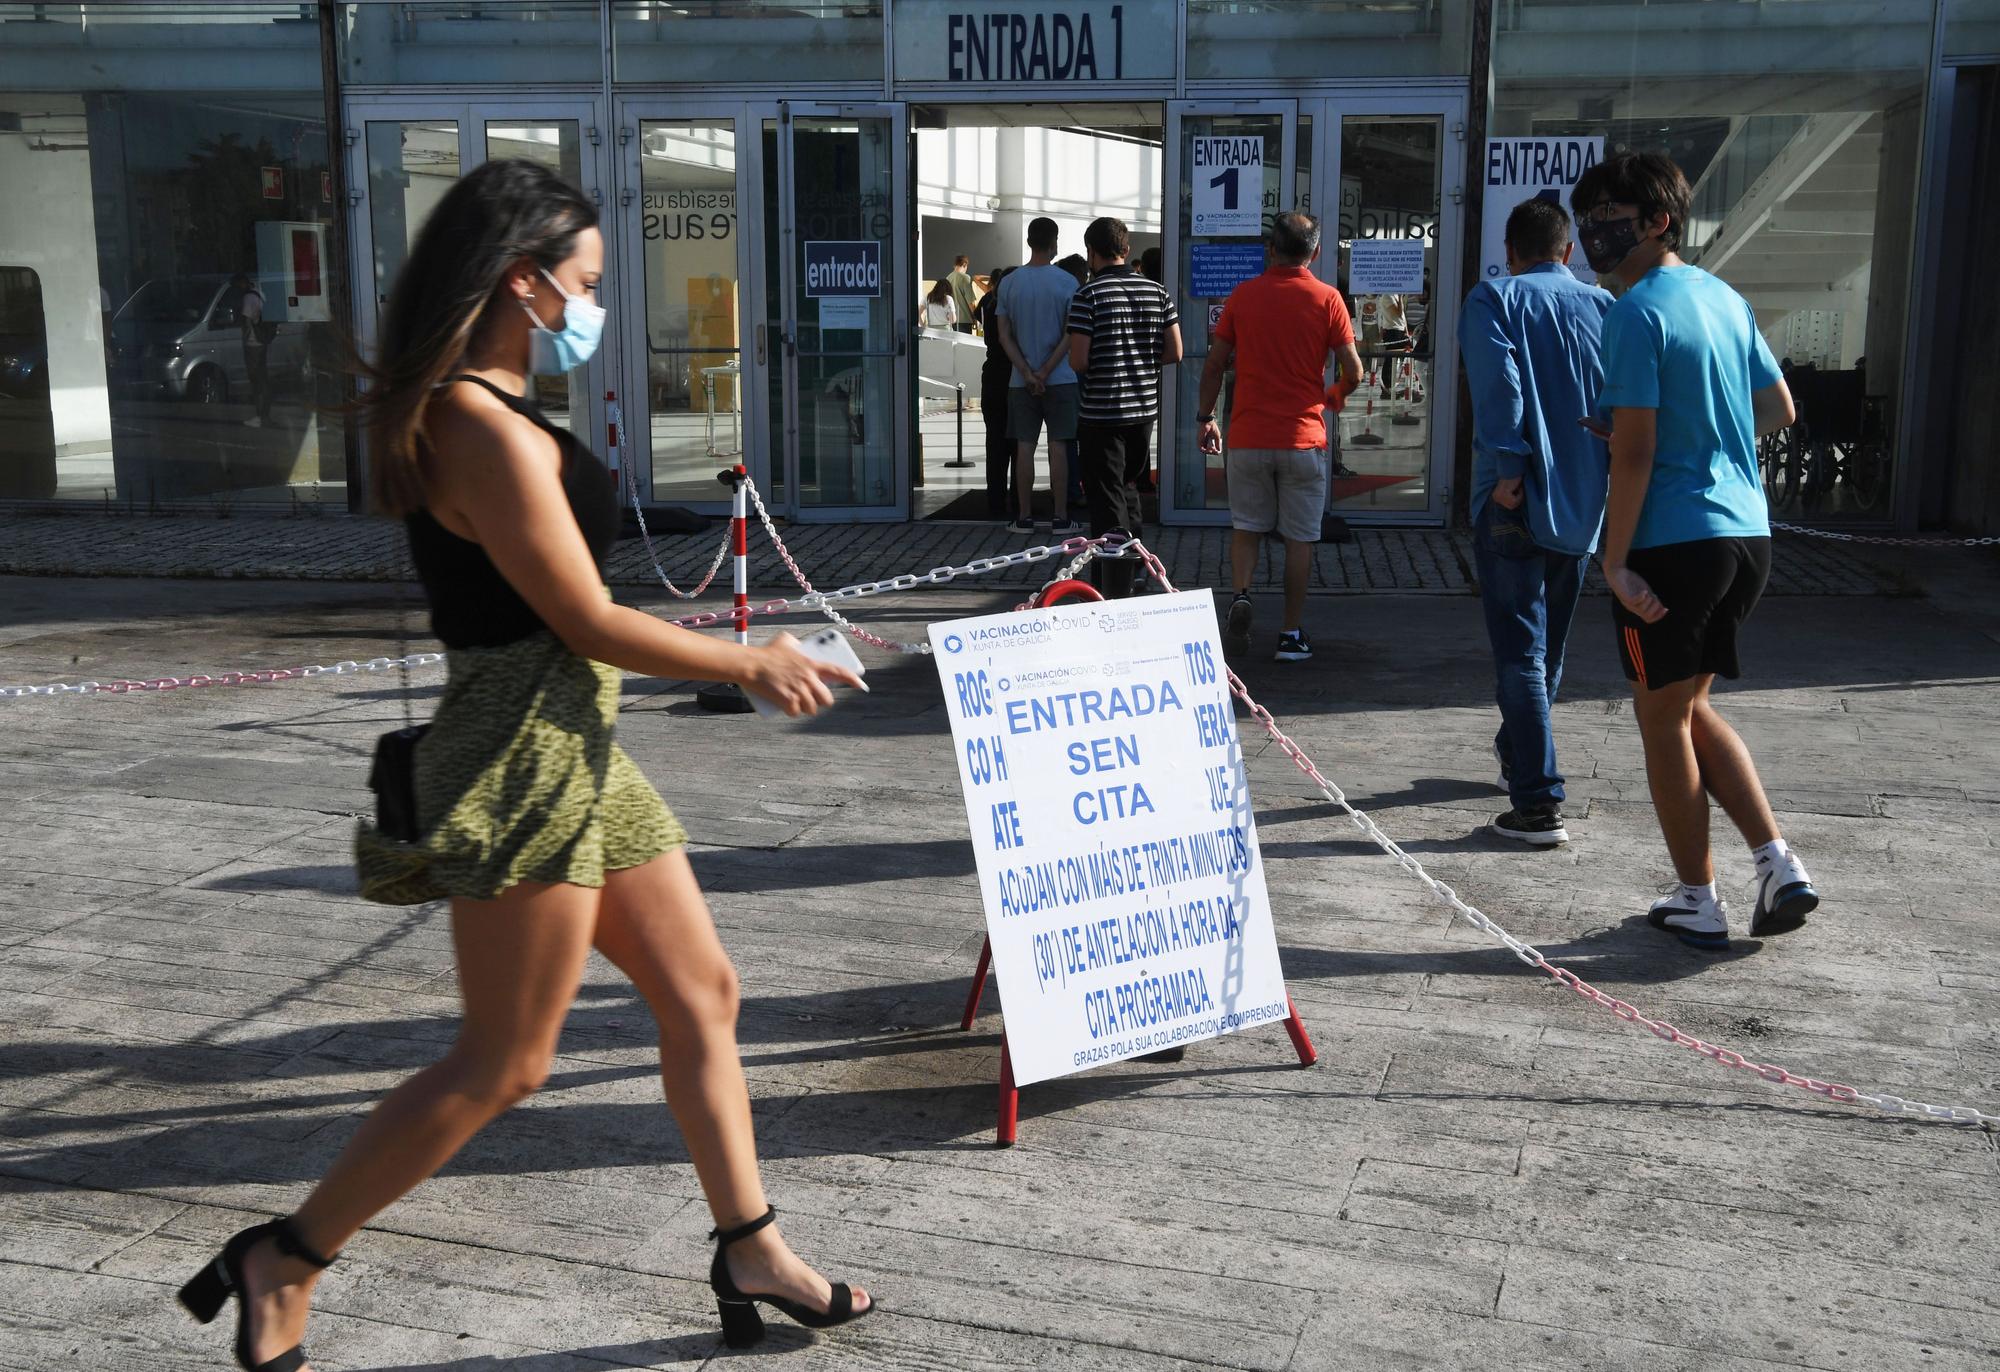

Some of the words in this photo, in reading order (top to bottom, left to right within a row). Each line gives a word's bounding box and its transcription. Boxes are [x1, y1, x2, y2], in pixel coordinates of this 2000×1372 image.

[949, 13, 1097, 81] ENTRADA
[1111, 5, 1122, 80] 1
[1194, 139, 1260, 166] ENTRADA
[1488, 142, 1596, 186] ENTRADA
[1210, 168, 1239, 210] 1
[808, 250, 878, 288] entrada
[973, 640, 1002, 652] XUNTA
[1003, 638, 1016, 648] DE
[1017, 633, 1052, 647] GALICIA
[1005, 680, 1183, 735] ENTRADA
[1067, 734, 1141, 775] SEN
[1073, 783, 1155, 825] CITA
[999, 861, 1059, 918] ACUDAN
[1058, 855, 1091, 906] CON
[1088, 841, 1124, 900] MÁIS
[1122, 845, 1146, 892] DE
[1142, 837, 1193, 888] TRINTA
[1188, 826, 1248, 880] MINUTOS
[1062, 926, 1087, 974] DE
[1085, 894, 1170, 971] ANTELACIÓN
[1179, 898, 1221, 948] HORA
[1217, 894, 1240, 940] DA
[1085, 988, 1119, 1039] CITA
[1115, 968, 1214, 1032] PROGRAMADA.
[1073, 1044, 1109, 1066] GRAZAS
[1111, 1039, 1134, 1058] POLA
[1135, 1033, 1153, 1051] SUA
[1154, 1015, 1220, 1046] COLABORACIÓN
[1220, 1016, 1227, 1030] E
[1228, 1000, 1286, 1028] COMPRENSIÓN
